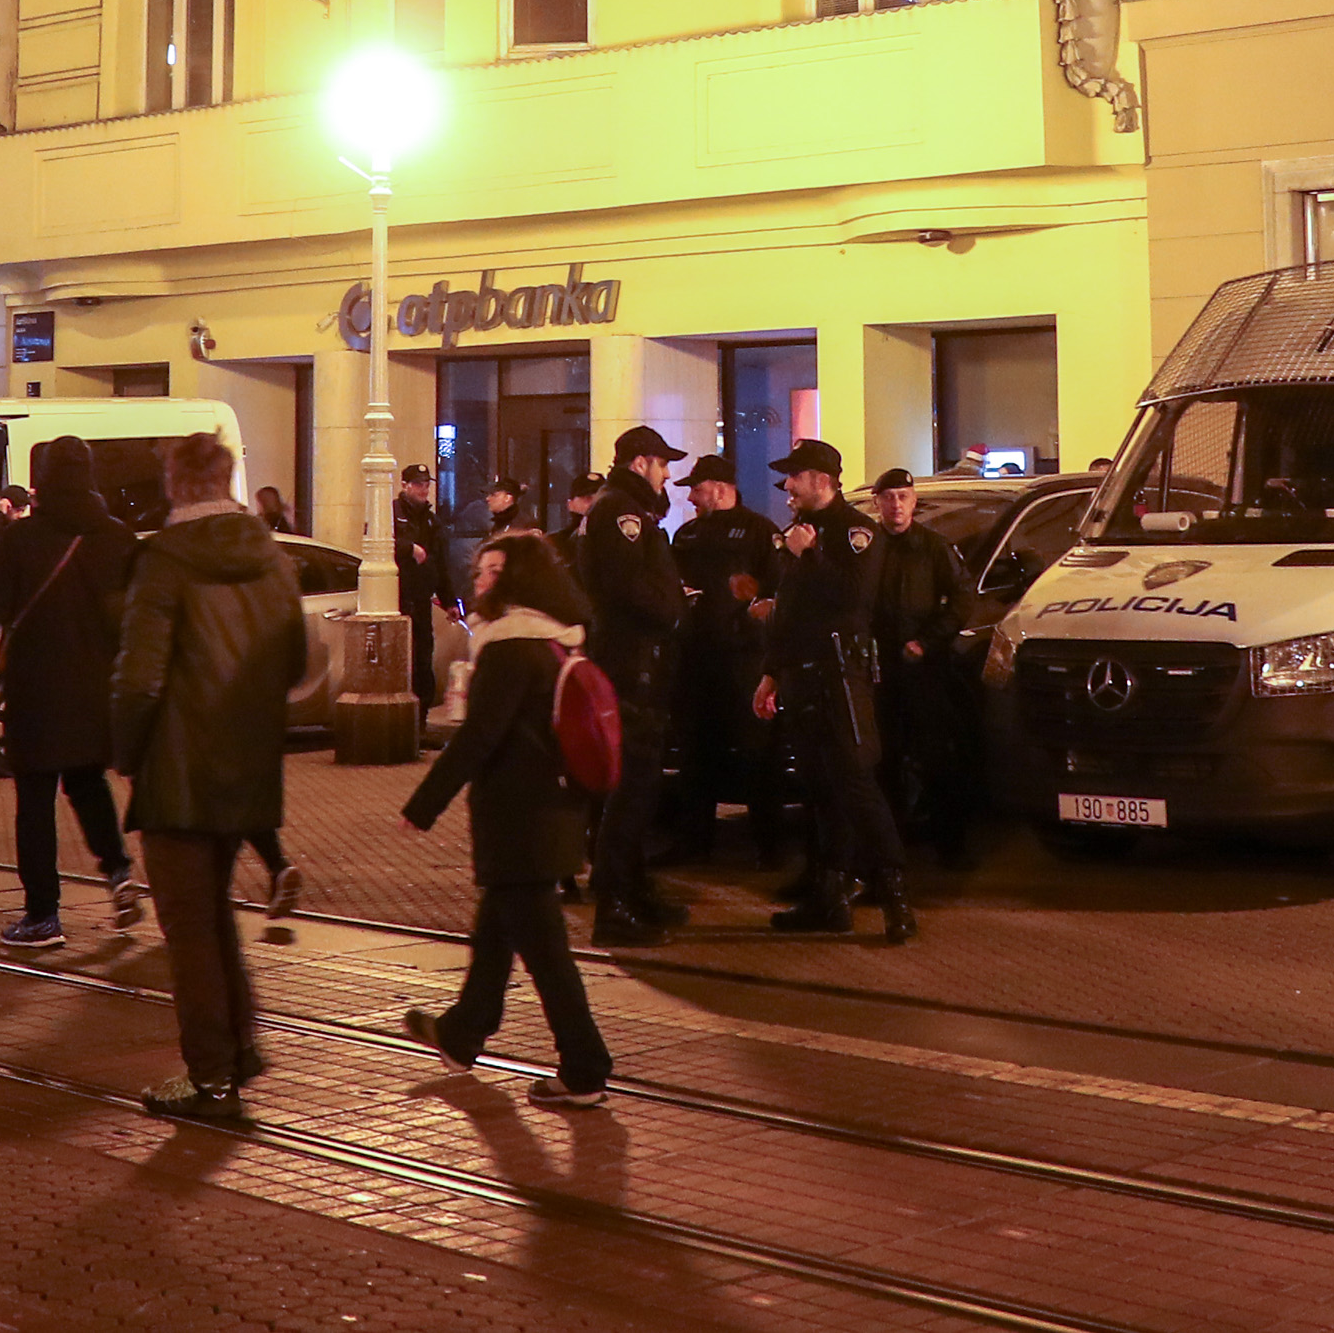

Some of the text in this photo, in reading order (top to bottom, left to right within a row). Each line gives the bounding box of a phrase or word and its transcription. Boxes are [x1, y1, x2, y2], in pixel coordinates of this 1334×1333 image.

[1036, 596, 1237, 622] POLICIJA
[1075, 797, 1149, 822] 190 885
